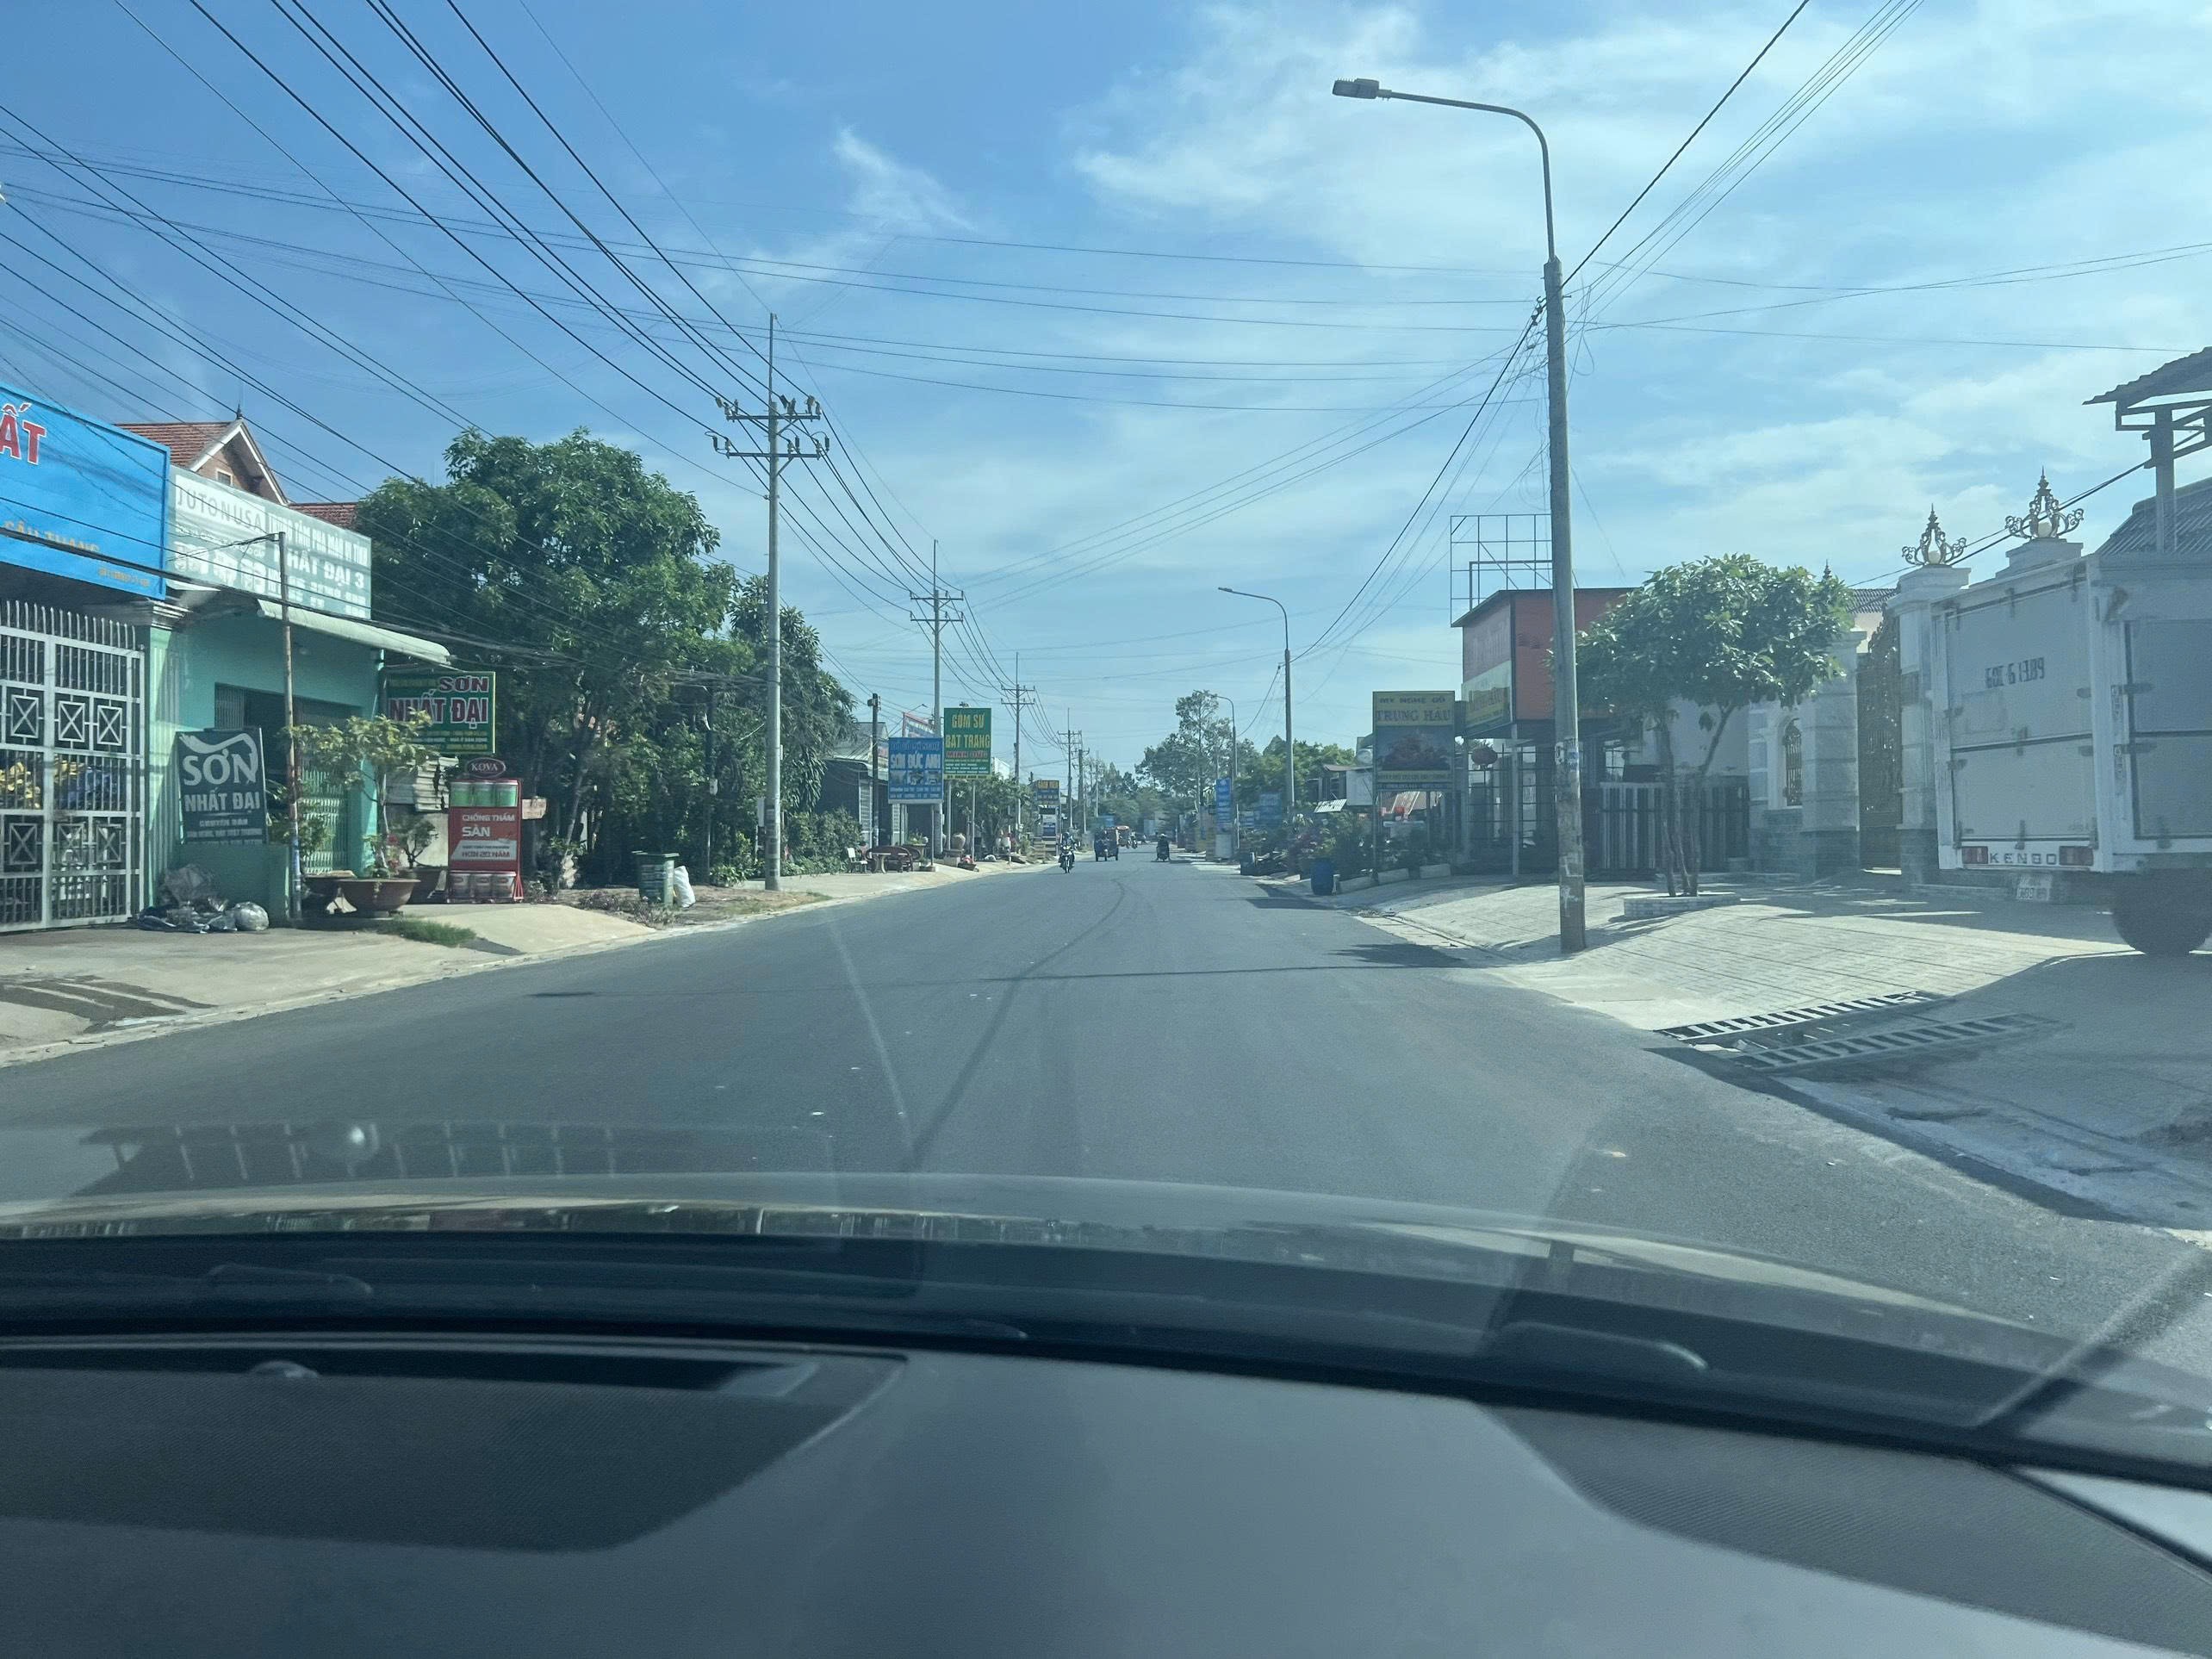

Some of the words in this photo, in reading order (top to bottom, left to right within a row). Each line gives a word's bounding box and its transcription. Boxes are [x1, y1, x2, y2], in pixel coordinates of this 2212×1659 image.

[323, 561, 351, 587] ĐẠI
[355, 572, 365, 589] 3
[439, 675, 489, 693] SƠN
[450, 697, 488, 730] ĐẠI
[182, 746, 258, 786] SƠN
[183, 786, 227, 811] NHẤT
[232, 792, 260, 813] ĐẠI
